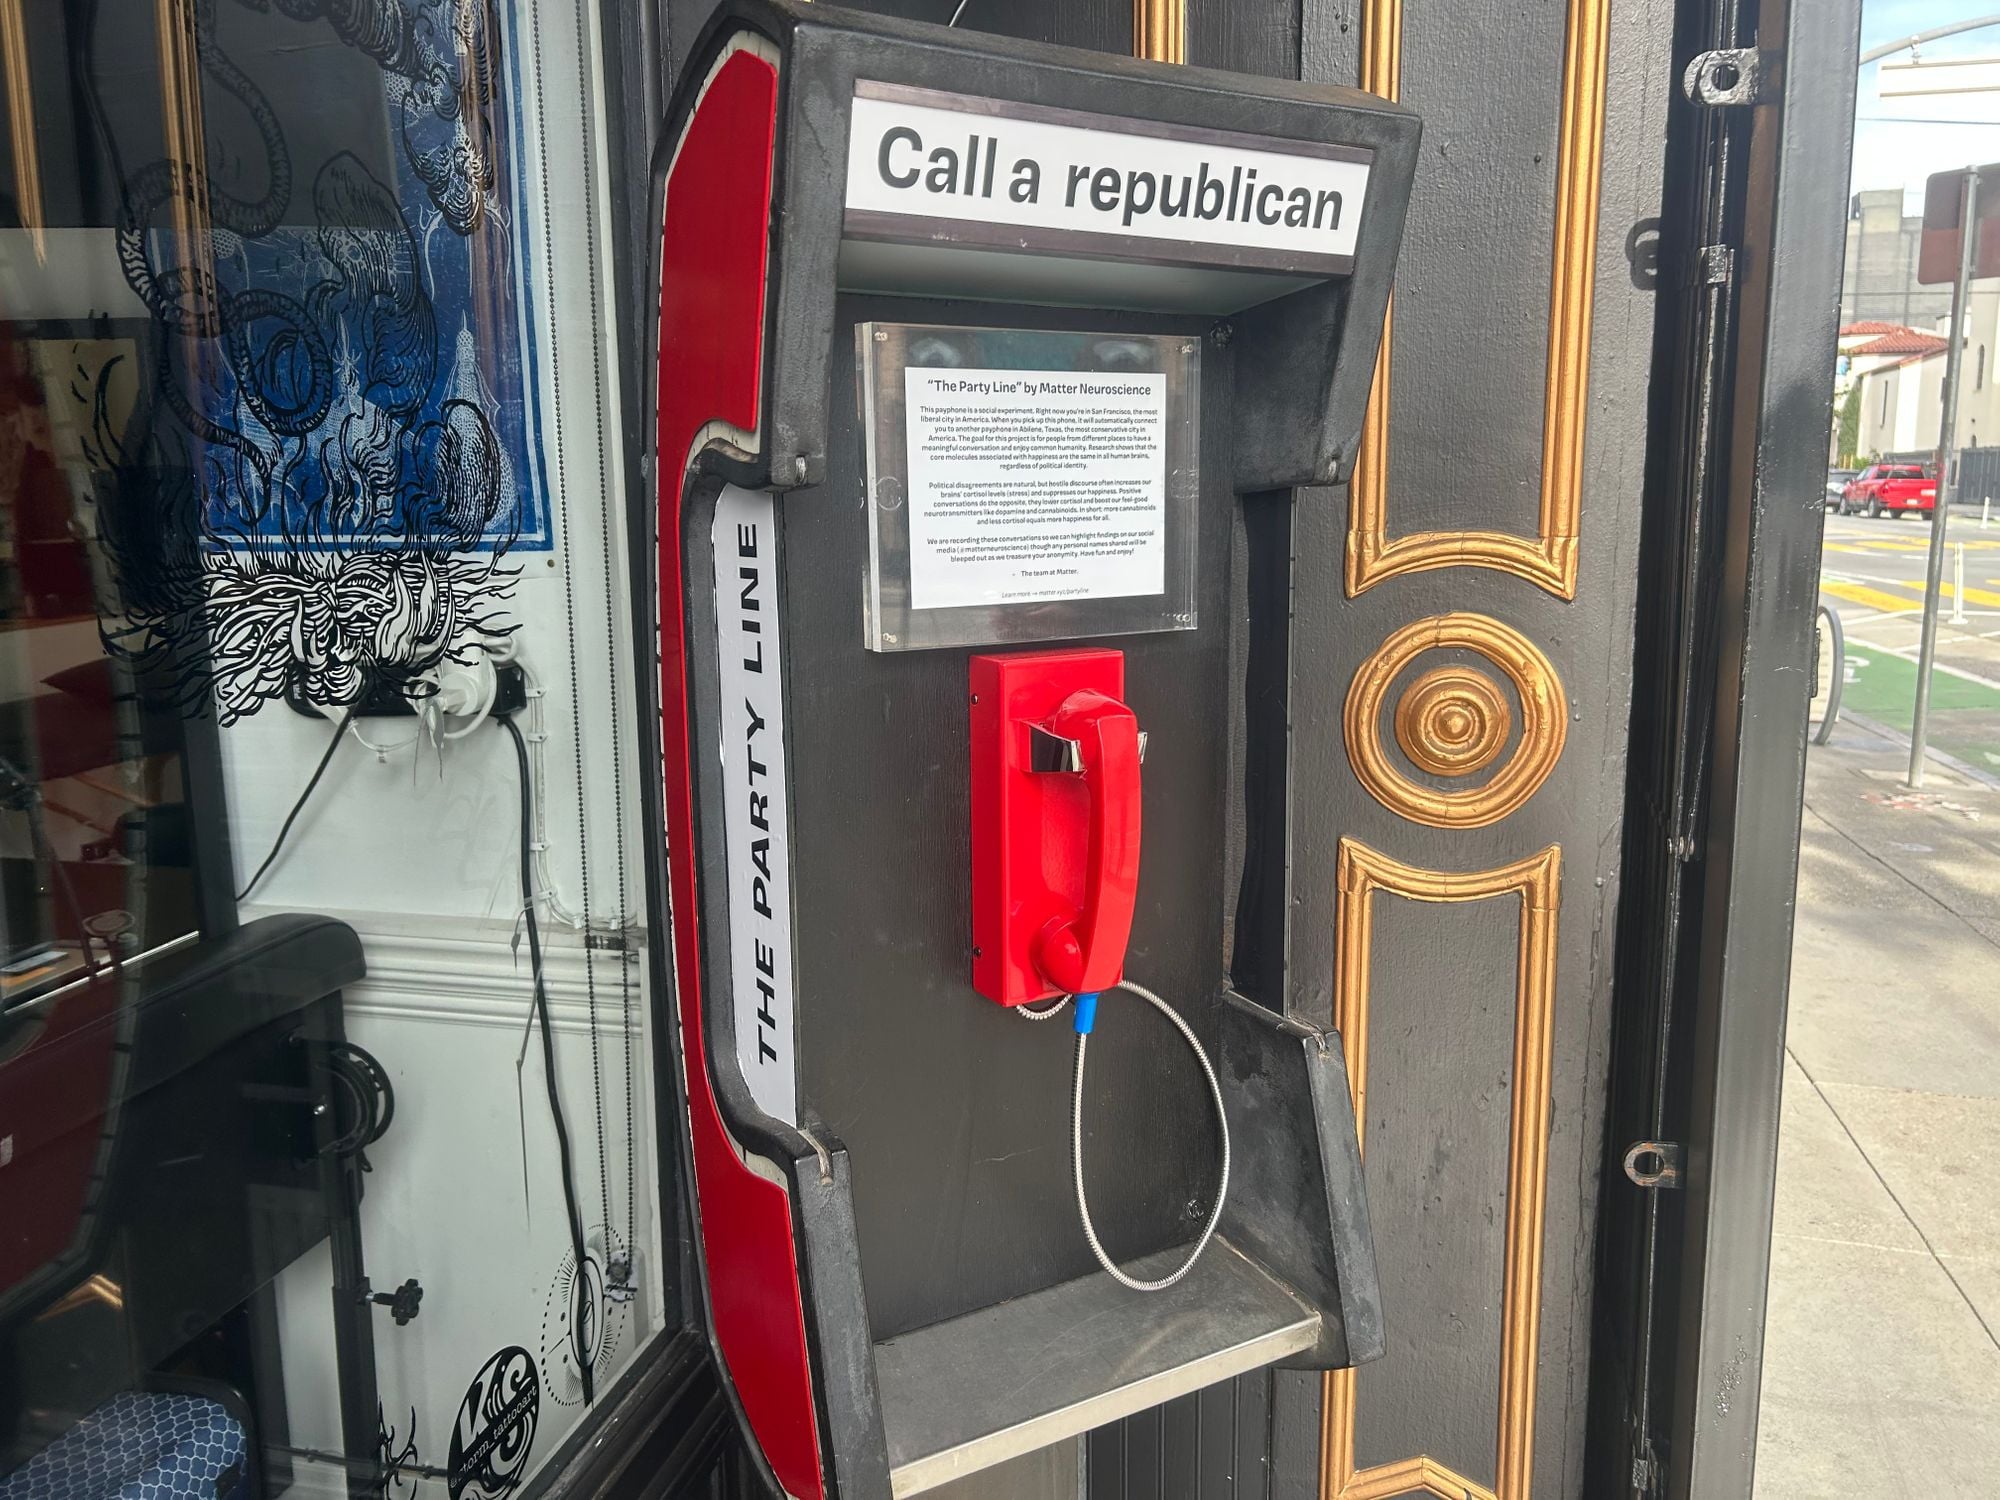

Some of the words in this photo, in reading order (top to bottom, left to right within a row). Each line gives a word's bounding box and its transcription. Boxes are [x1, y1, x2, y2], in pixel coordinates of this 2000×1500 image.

[877, 126, 998, 199] Call
[1010, 158, 1042, 205] a
[1065, 163, 1344, 231] republican
[958, 379, 990, 395] Party
[1023, 380, 1037, 396] by
[1039, 381, 1077, 396] Matter
[1079, 382, 1151, 398] Neuroscience
[920, 405, 934, 413] This
[934, 406, 966, 414] payphone
[967, 405, 973, 414] is
[978, 405, 997, 414] social
[1035, 406, 1051, 416] Right
[1084, 407, 1090, 415] in
[1091, 407, 1102, 415] San
[920, 414, 941, 423] liberal
[941, 415, 954, 424] city
[954, 415, 961, 423] in
[990, 415, 1009, 423] When
[1010, 417, 1022, 425] you
[1022, 416, 1035, 424] pick
[1035, 414, 1044, 424] up
[1044, 416, 1056, 424] this
[1077, 416, 1082, 424] it
[1082, 416, 1094, 424] will
[934, 426, 946, 434] you
[947, 425, 954, 433] to
[980, 425, 1011, 433] payphone
[1064, 425, 1074, 433] the
[1128, 426, 1139, 434] city
[1139, 425, 1146, 433] in
[958, 434, 970, 442] The
[970, 434, 984, 443] goal
[984, 434, 994, 442] for
[994, 434, 1007, 442] this
[1007, 435, 1029, 443] project
[1030, 434, 1035, 442] is
[1036, 434, 1045, 442] for
[1045, 435, 1065, 443] people
[1066, 434, 1081, 442] from
[1081, 434, 1106, 442] different
[921, 443, 958, 452] meaningful
[1012, 444, 1029, 452] enjoy
[945, 453, 978, 461] molecules
[978, 453, 1012, 461] associated
[1012, 452, 1027, 460] with
[1027, 453, 1058, 461] happiness
[1069, 452, 1079, 460] the
[999, 462, 1031, 470] regardless
[1031, 461, 1038, 469] of
[1038, 461, 1062, 470] political
[928, 480, 955, 489] Political
[955, 481, 1002, 489] disagreements
[1037, 480, 1048, 488] but
[1048, 479, 1068, 487] hostile
[1069, 479, 1097, 487] discourse
[962, 490, 987, 498] cortisol
[987, 489, 1005, 498] levels
[1042, 489, 1076, 497] suppresses
[933, 500, 978, 508] conversations
[978, 499, 987, 507] do
[1027, 498, 1041, 506] they
[1059, 497, 1082, 505] cortisol
[1094, 496, 1110, 504] boost
[923, 509, 982, 517] neurotransmitters
[983, 508, 994, 516] like
[994, 508, 1025, 516] dopamine
[1026, 507, 1038, 515] and
[976, 517, 988, 525] and
[988, 517, 1001, 525] less
[1002, 516, 1025, 524] cortisol
[1025, 516, 1045, 524] equals
[1062, 515, 1092, 523] happiness
[926, 537, 937, 545] We
[949, 536, 980, 545] recording
[980, 535, 998, 543] these
[998, 534, 1041, 542] conversations
[1070, 531, 1096, 541] highlight
[1096, 530, 1119, 539] findings
[936, 546, 956, 554] media
[1029, 542, 1051, 551] though
[1051, 542, 1062, 550] any
[1063, 541, 1088, 549] personal
[1108, 539, 1128, 547] shared
[950, 554, 975, 563] bleeped
[976, 554, 986, 562] out
[1031, 552, 1045, 560] your
[1079, 549, 1094, 557] Have
[1095, 548, 1105, 556] fun
[1105, 548, 1116, 556] and
[1021, 569, 1032, 577] The
[1033, 569, 1048, 577] team
[737, 523, 765, 675] LINE
[745, 697, 773, 920] PARTY
[754, 938, 777, 1065] THE
